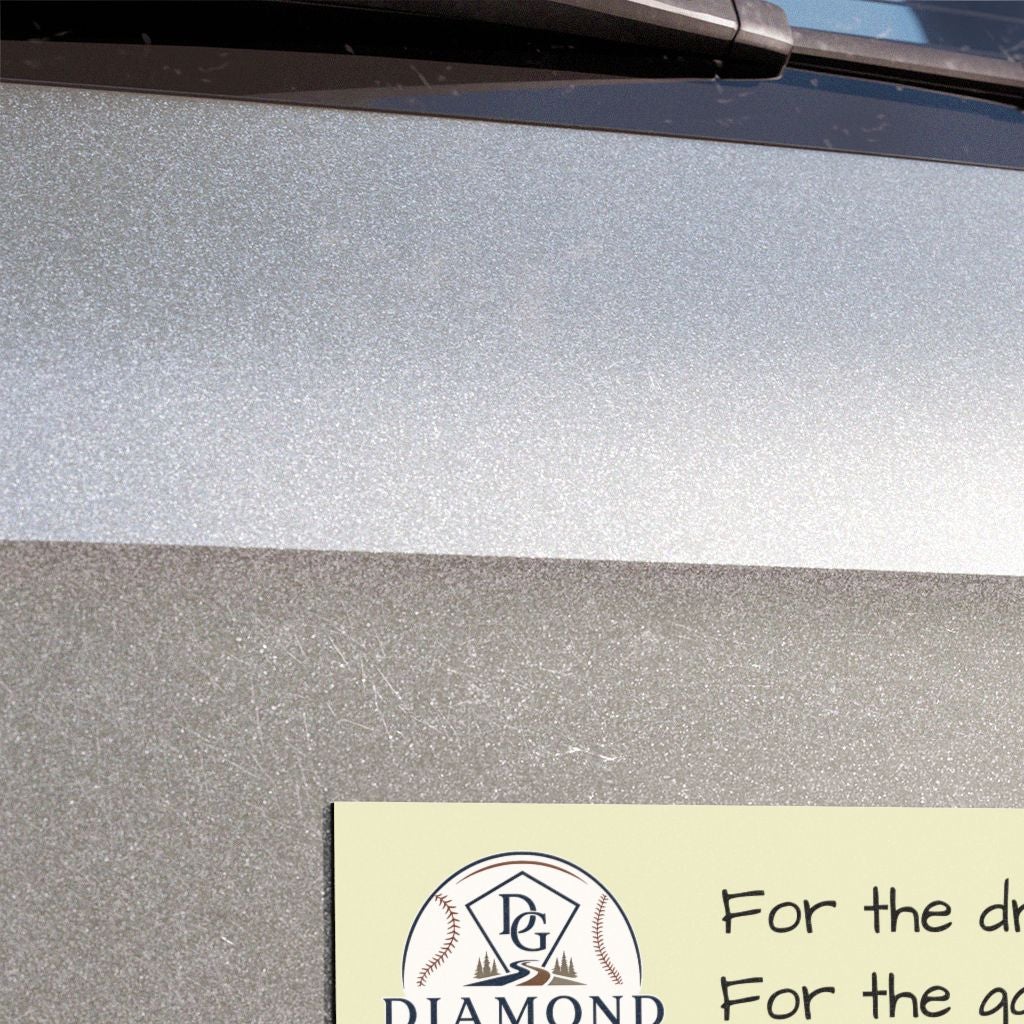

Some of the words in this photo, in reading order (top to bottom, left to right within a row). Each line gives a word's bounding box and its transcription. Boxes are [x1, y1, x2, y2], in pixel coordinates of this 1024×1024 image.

[499, 894, 550, 951] DG
[722, 889, 836, 933] For
[864, 886, 952, 933] the
[720, 976, 835, 1021] For
[862, 972, 951, 1019] the
